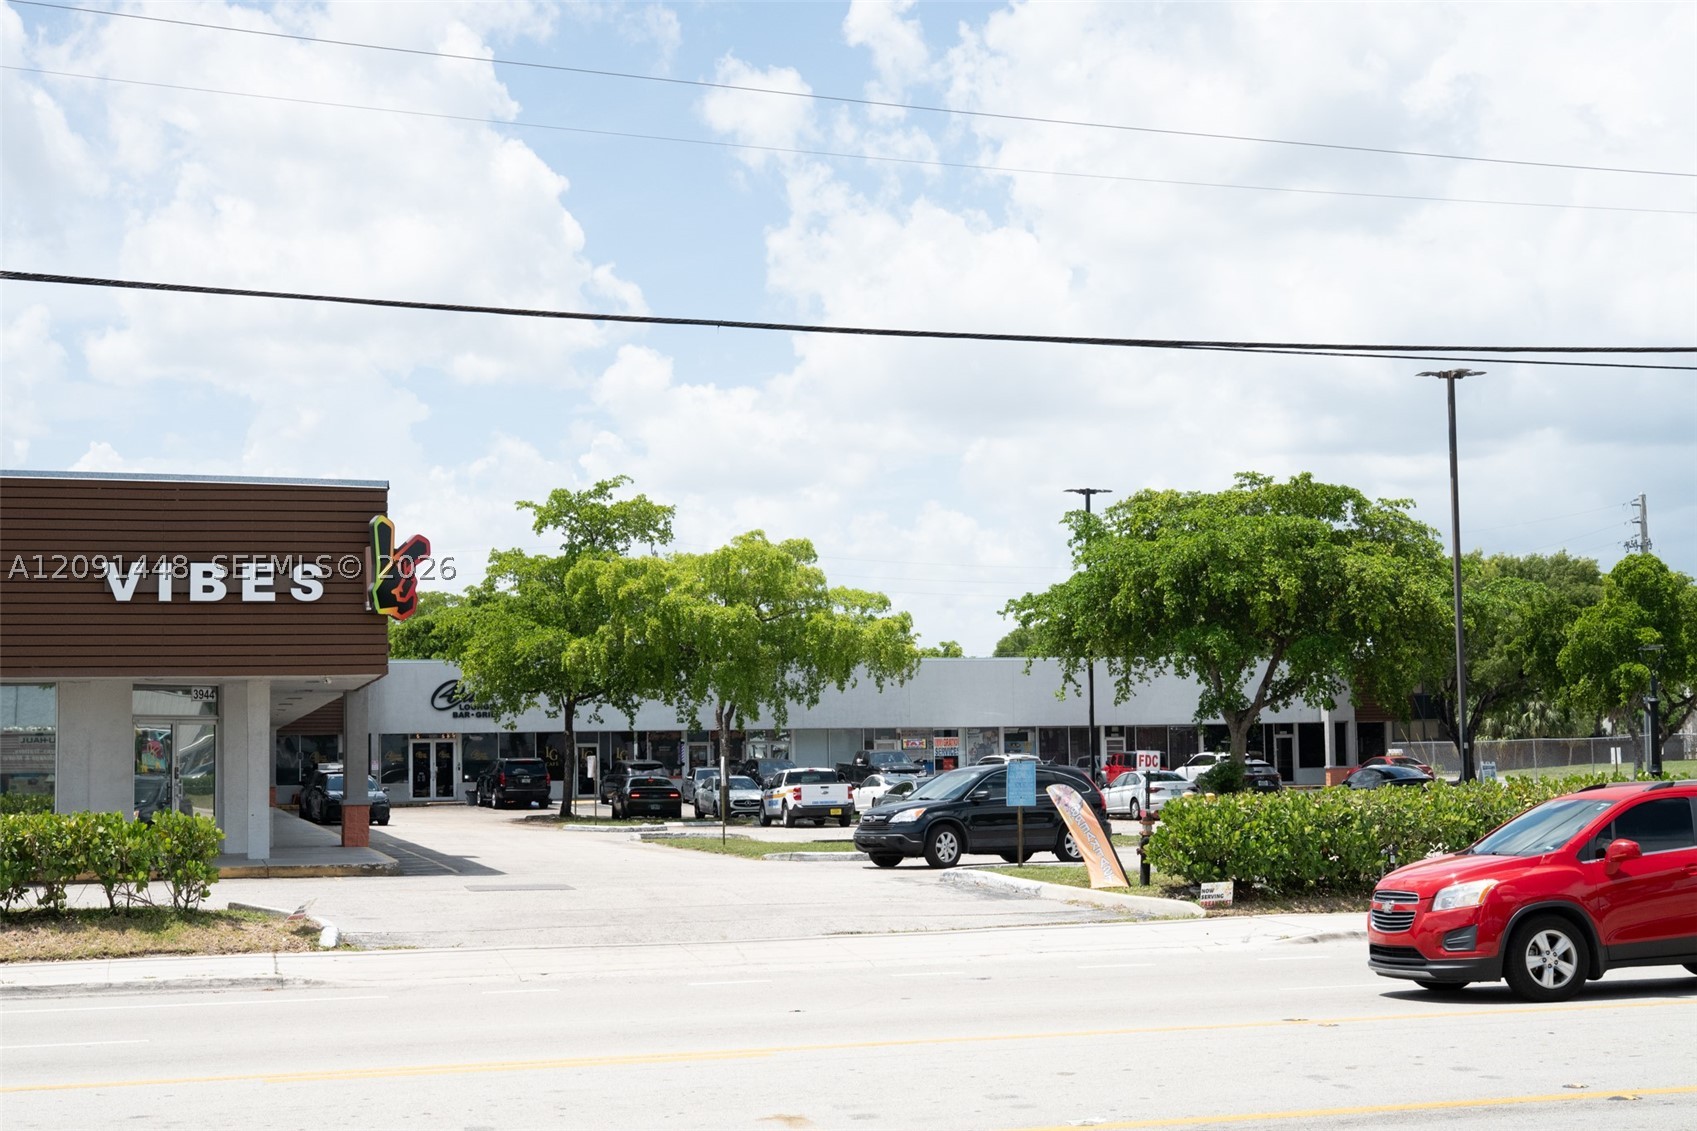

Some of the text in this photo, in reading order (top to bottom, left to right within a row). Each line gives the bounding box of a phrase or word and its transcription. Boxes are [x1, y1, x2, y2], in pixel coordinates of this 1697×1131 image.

[102, 561, 325, 602] VIBES
[193, 689, 215, 700] 3944
[452, 711, 470, 719] BAR
[1138, 754, 1159, 768] FDC
